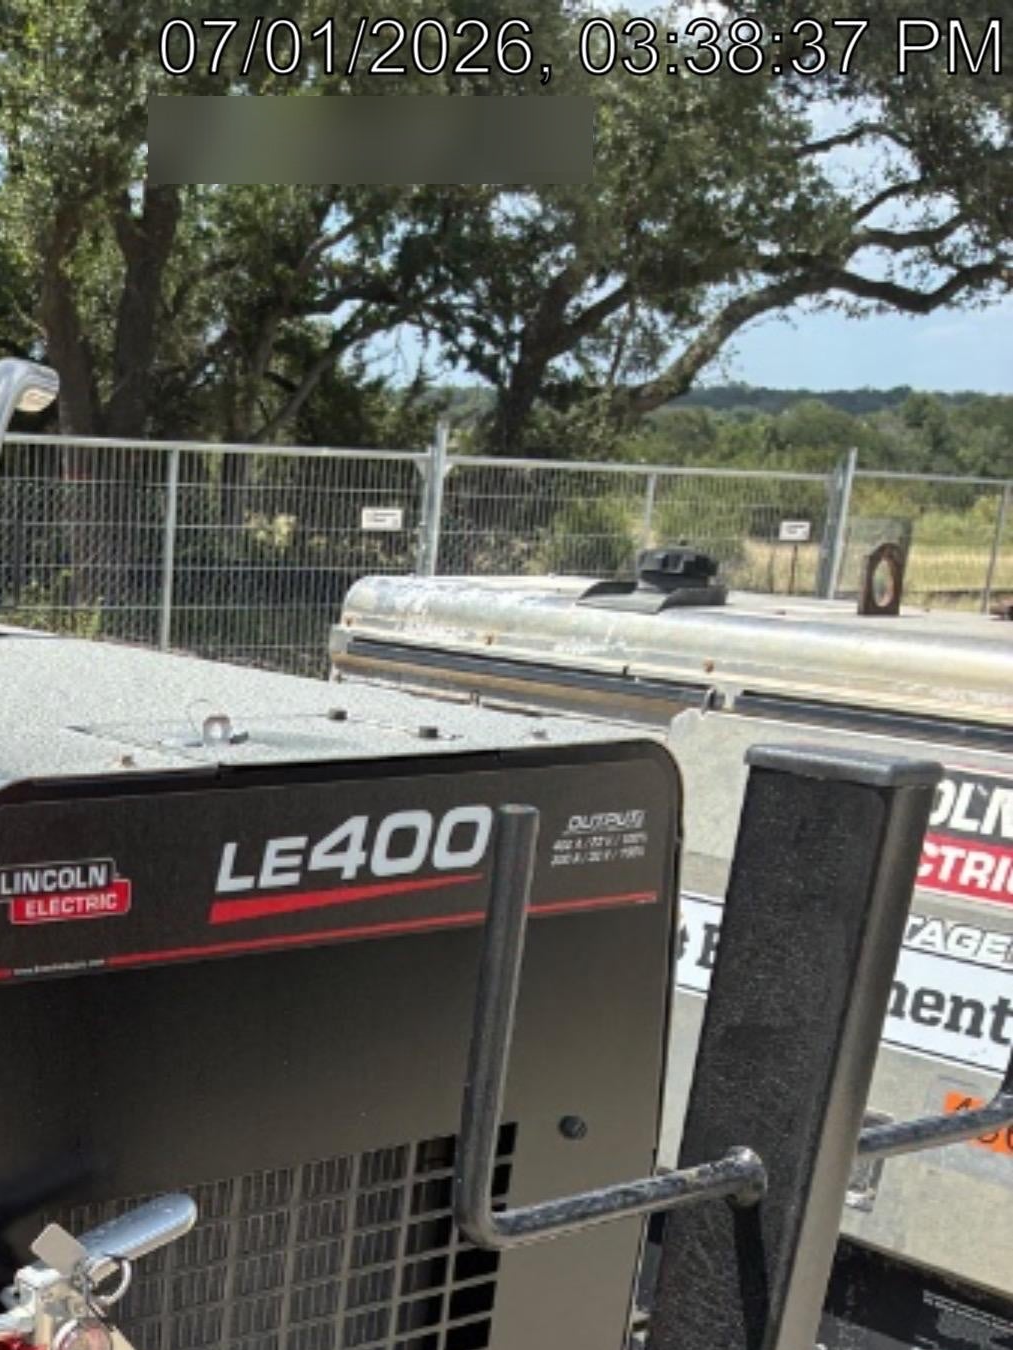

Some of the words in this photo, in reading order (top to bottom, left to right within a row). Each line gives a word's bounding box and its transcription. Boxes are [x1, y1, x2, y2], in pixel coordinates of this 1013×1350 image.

[214, 805, 494, 893] LE400
[0, 862, 108, 896] LINCOLN
[23, 892, 119, 919] ELECTRIC
